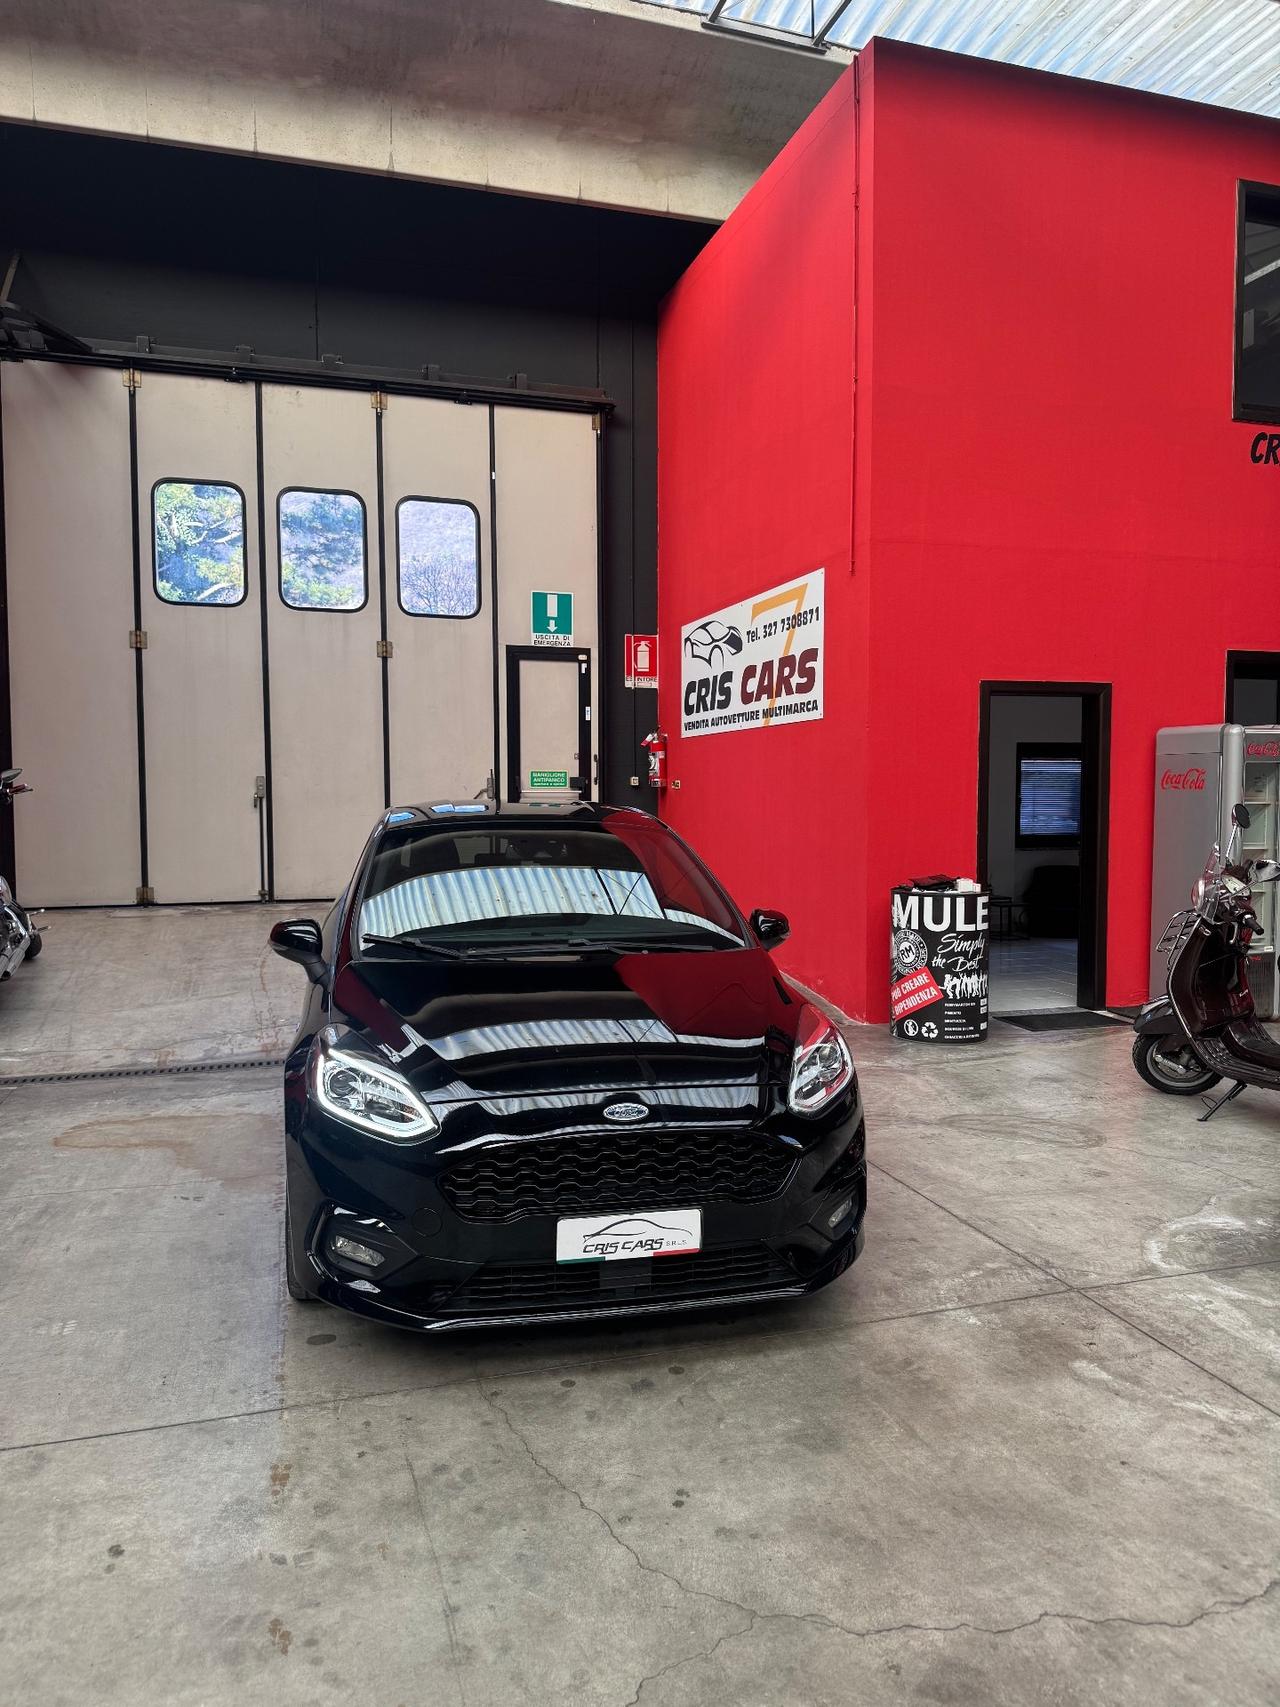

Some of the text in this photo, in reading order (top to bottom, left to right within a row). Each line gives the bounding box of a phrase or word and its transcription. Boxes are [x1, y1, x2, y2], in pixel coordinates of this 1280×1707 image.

[1250, 431, 1280, 465] CR
[746, 606, 819, 643] Tel. 327 7308871
[684, 648, 819, 716] CRIS CARS
[684, 699, 819, 731] VENDITA AUTOVETTURE MULTIMARCA
[892, 893, 989, 932] MULE
[900, 945, 915, 960] RM
[937, 932, 985, 958] Simply
[931, 954, 946, 968] the
[947, 954, 983, 972] Best
[901, 972, 930, 994] CREARE
[894, 986, 938, 1015] DIPENDENZA
[583, 1242, 620, 1255] CRIS
[621, 1238, 664, 1252] CARS
